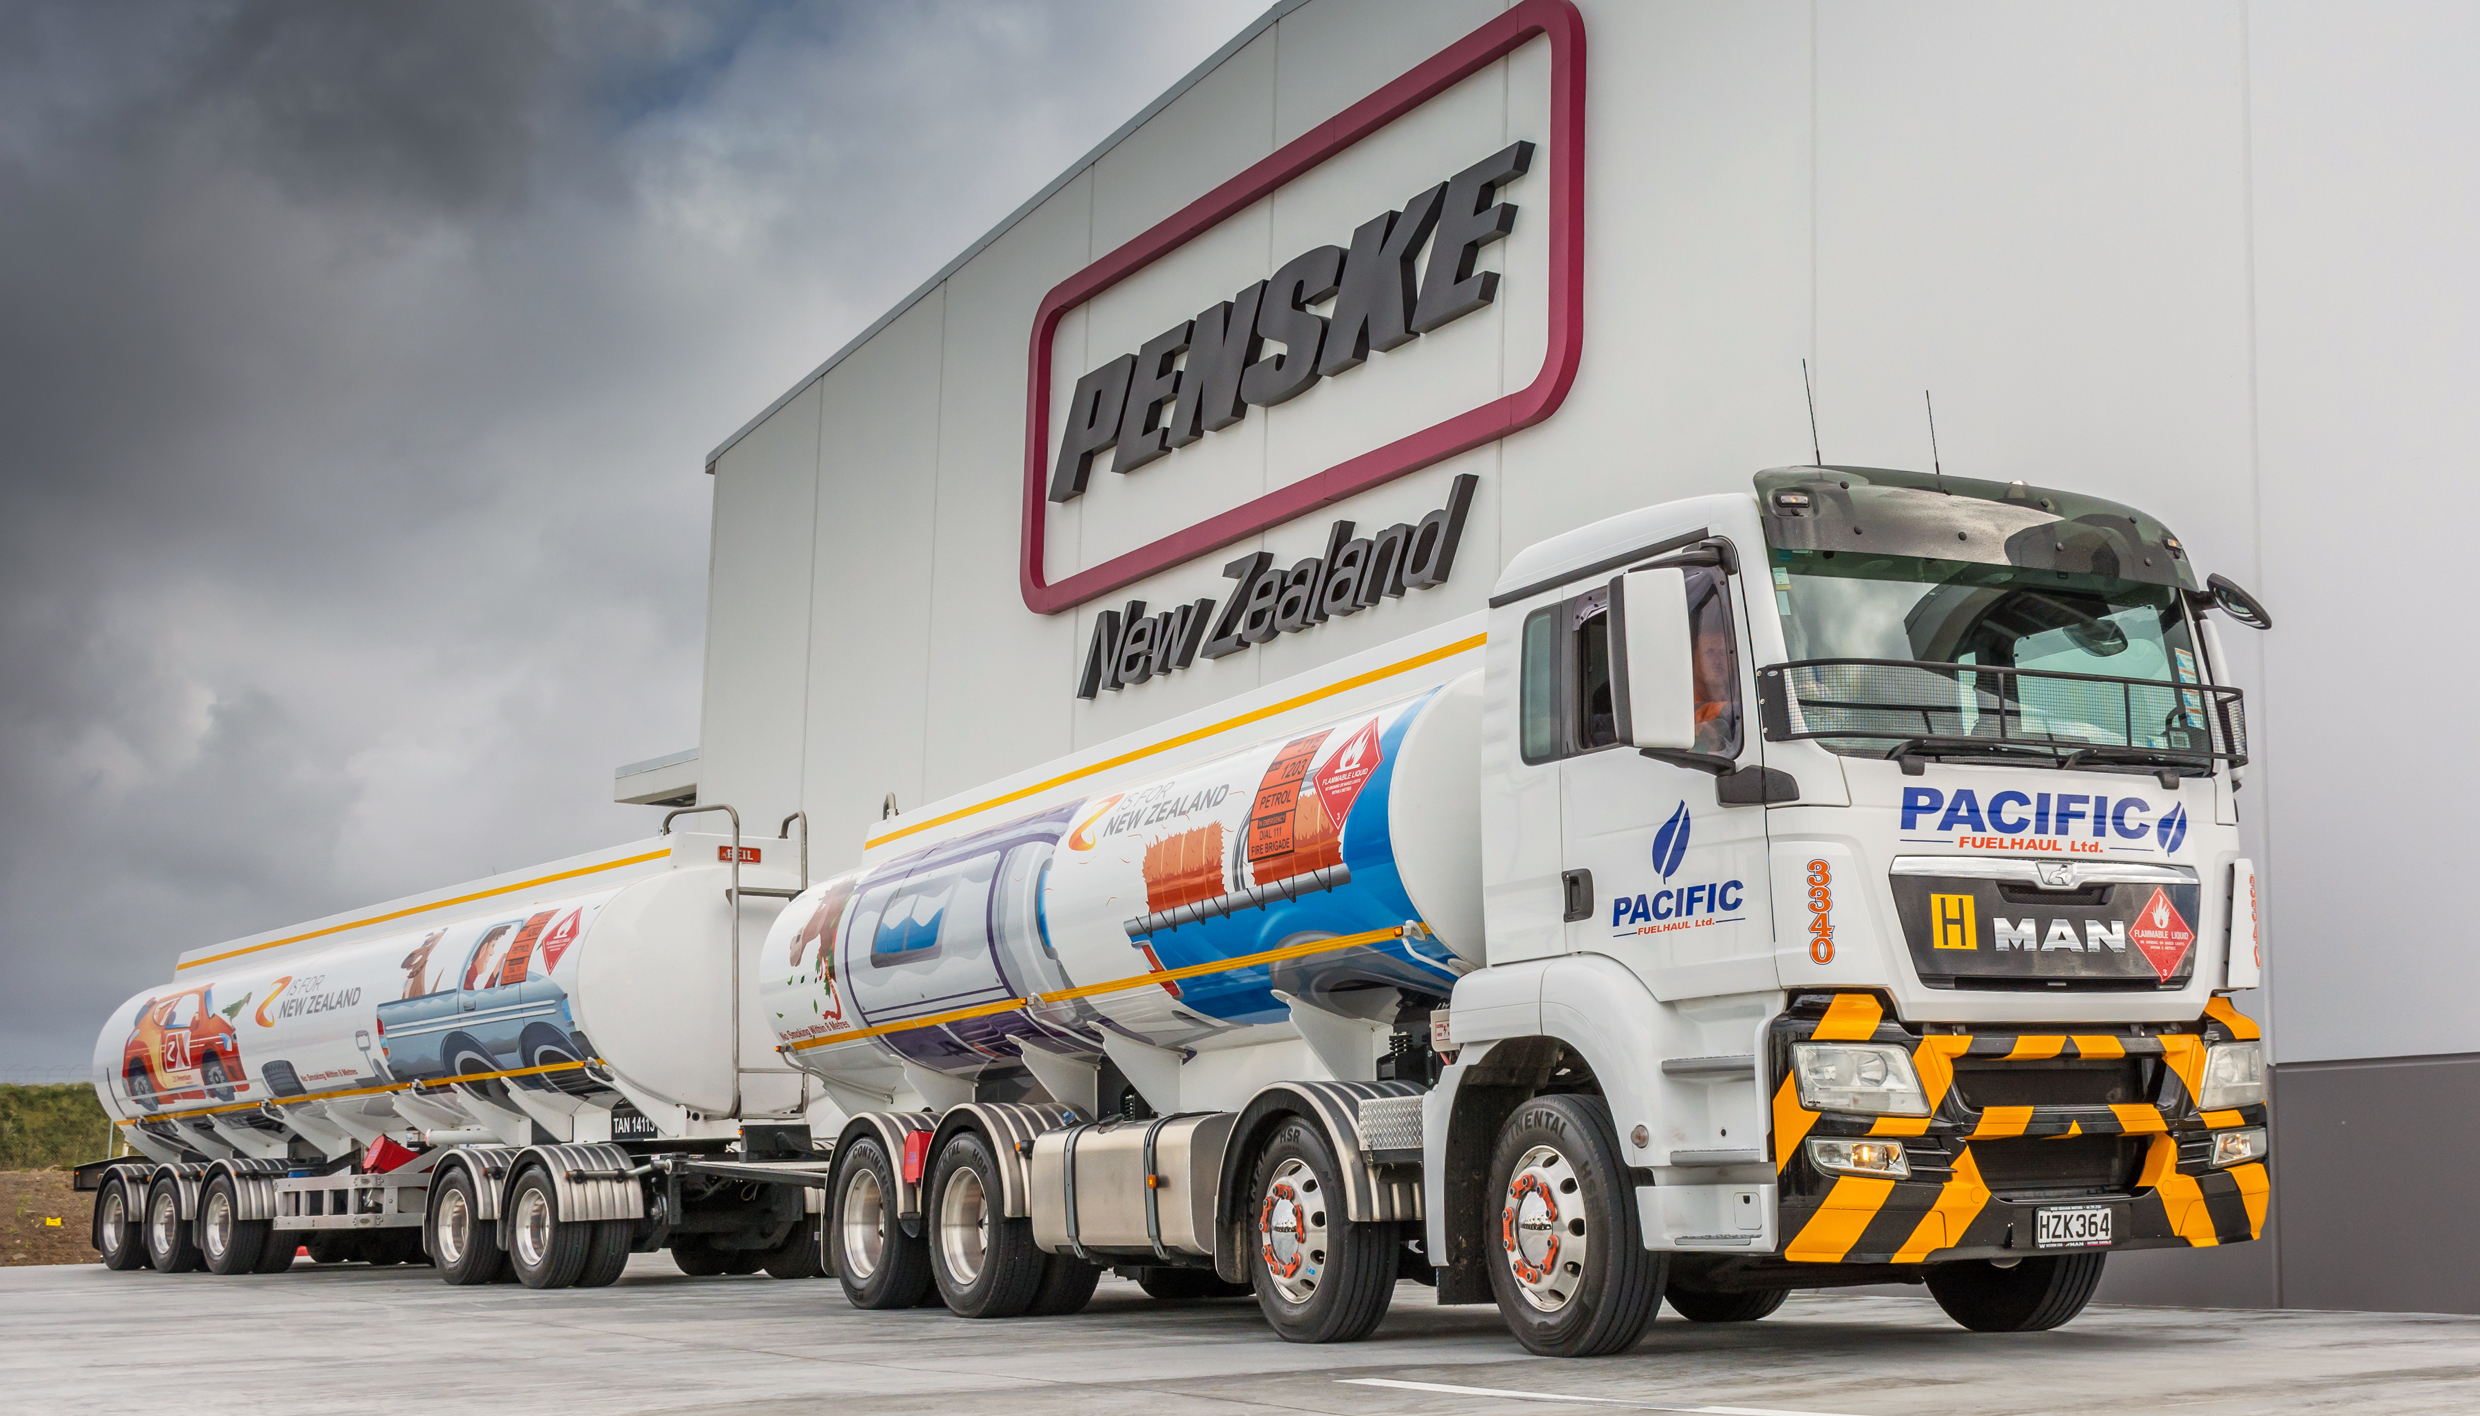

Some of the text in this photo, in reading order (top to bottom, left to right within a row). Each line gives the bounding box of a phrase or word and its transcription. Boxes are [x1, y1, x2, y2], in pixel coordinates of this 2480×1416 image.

[1049, 140, 1536, 503] PENSKE
[1077, 473, 1479, 700] New Zealand
[1281, 759, 1308, 779] 1203
[1116, 792, 1140, 813] IS
[1133, 781, 1176, 808] FOR
[1259, 790, 1291, 810] PETROL
[1103, 784, 1230, 837] NEW ZEALAND
[1900, 787, 2151, 840] PACIFIC
[1259, 826, 1282, 841] DIAL 111
[1251, 837, 1291, 857] FIRE BRIGADE
[1959, 836, 2104, 853] FUELHAUL Ltd.
[1612, 880, 1744, 927] PACIFIC
[1806, 858, 1836, 966] 3340
[1637, 918, 1716, 936] FUELHAUL Ltd.
[1940, 897, 1967, 947] H
[1993, 917, 2126, 953] MAN
[2134, 929, 2189, 940] FLAMMABLE LIQUID
[2162, 968, 2168, 977] 3
[298, 974, 326, 994] FOR
[278, 986, 362, 1018] NEW ZEALAND
[786, 1027, 812, 1040] Smoking
[829, 1020, 851, 1031] Metres
[613, 1117, 630, 1134] TAN
[1280, 1127, 1301, 1144] HSR
[2039, 1212, 2109, 1240] HZK364
